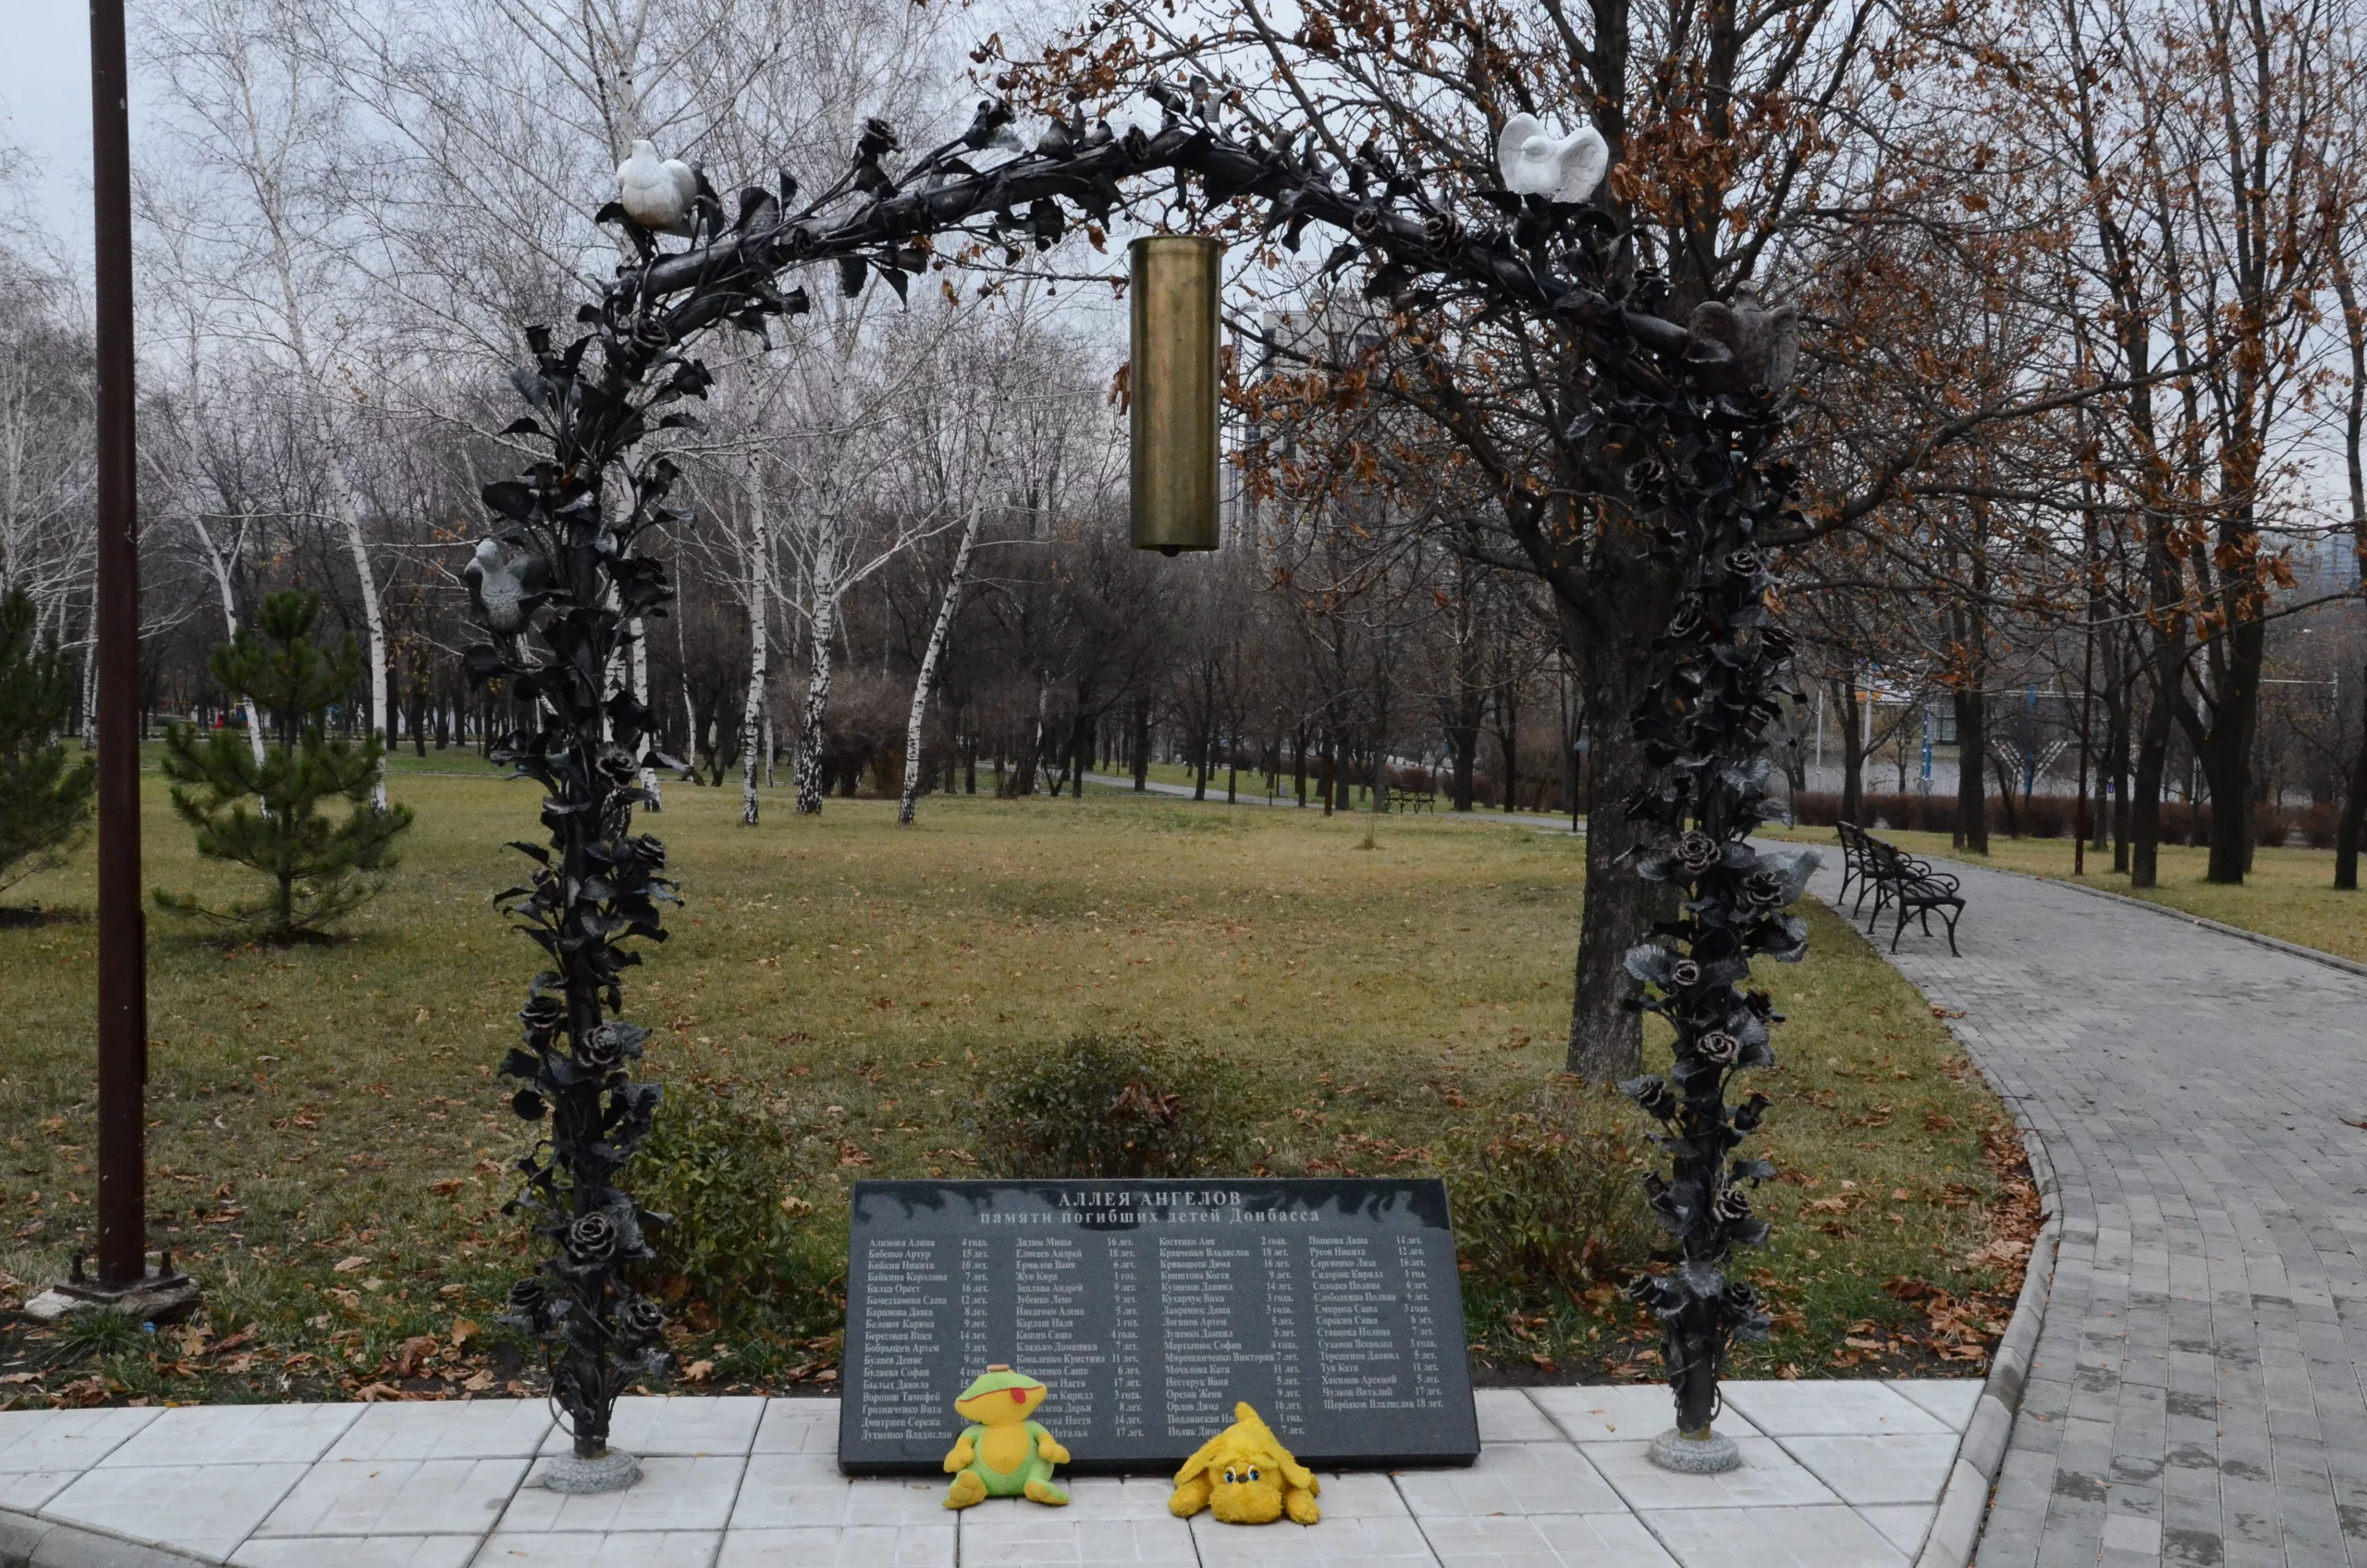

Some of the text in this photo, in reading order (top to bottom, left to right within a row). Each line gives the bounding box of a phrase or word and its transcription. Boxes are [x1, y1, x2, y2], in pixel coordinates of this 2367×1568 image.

[1059, 1192, 1242, 1207] АЛЛЕЯ АНГЕЛОВ
[980, 1209, 1319, 1225] памяти погибших детей Донбасса
